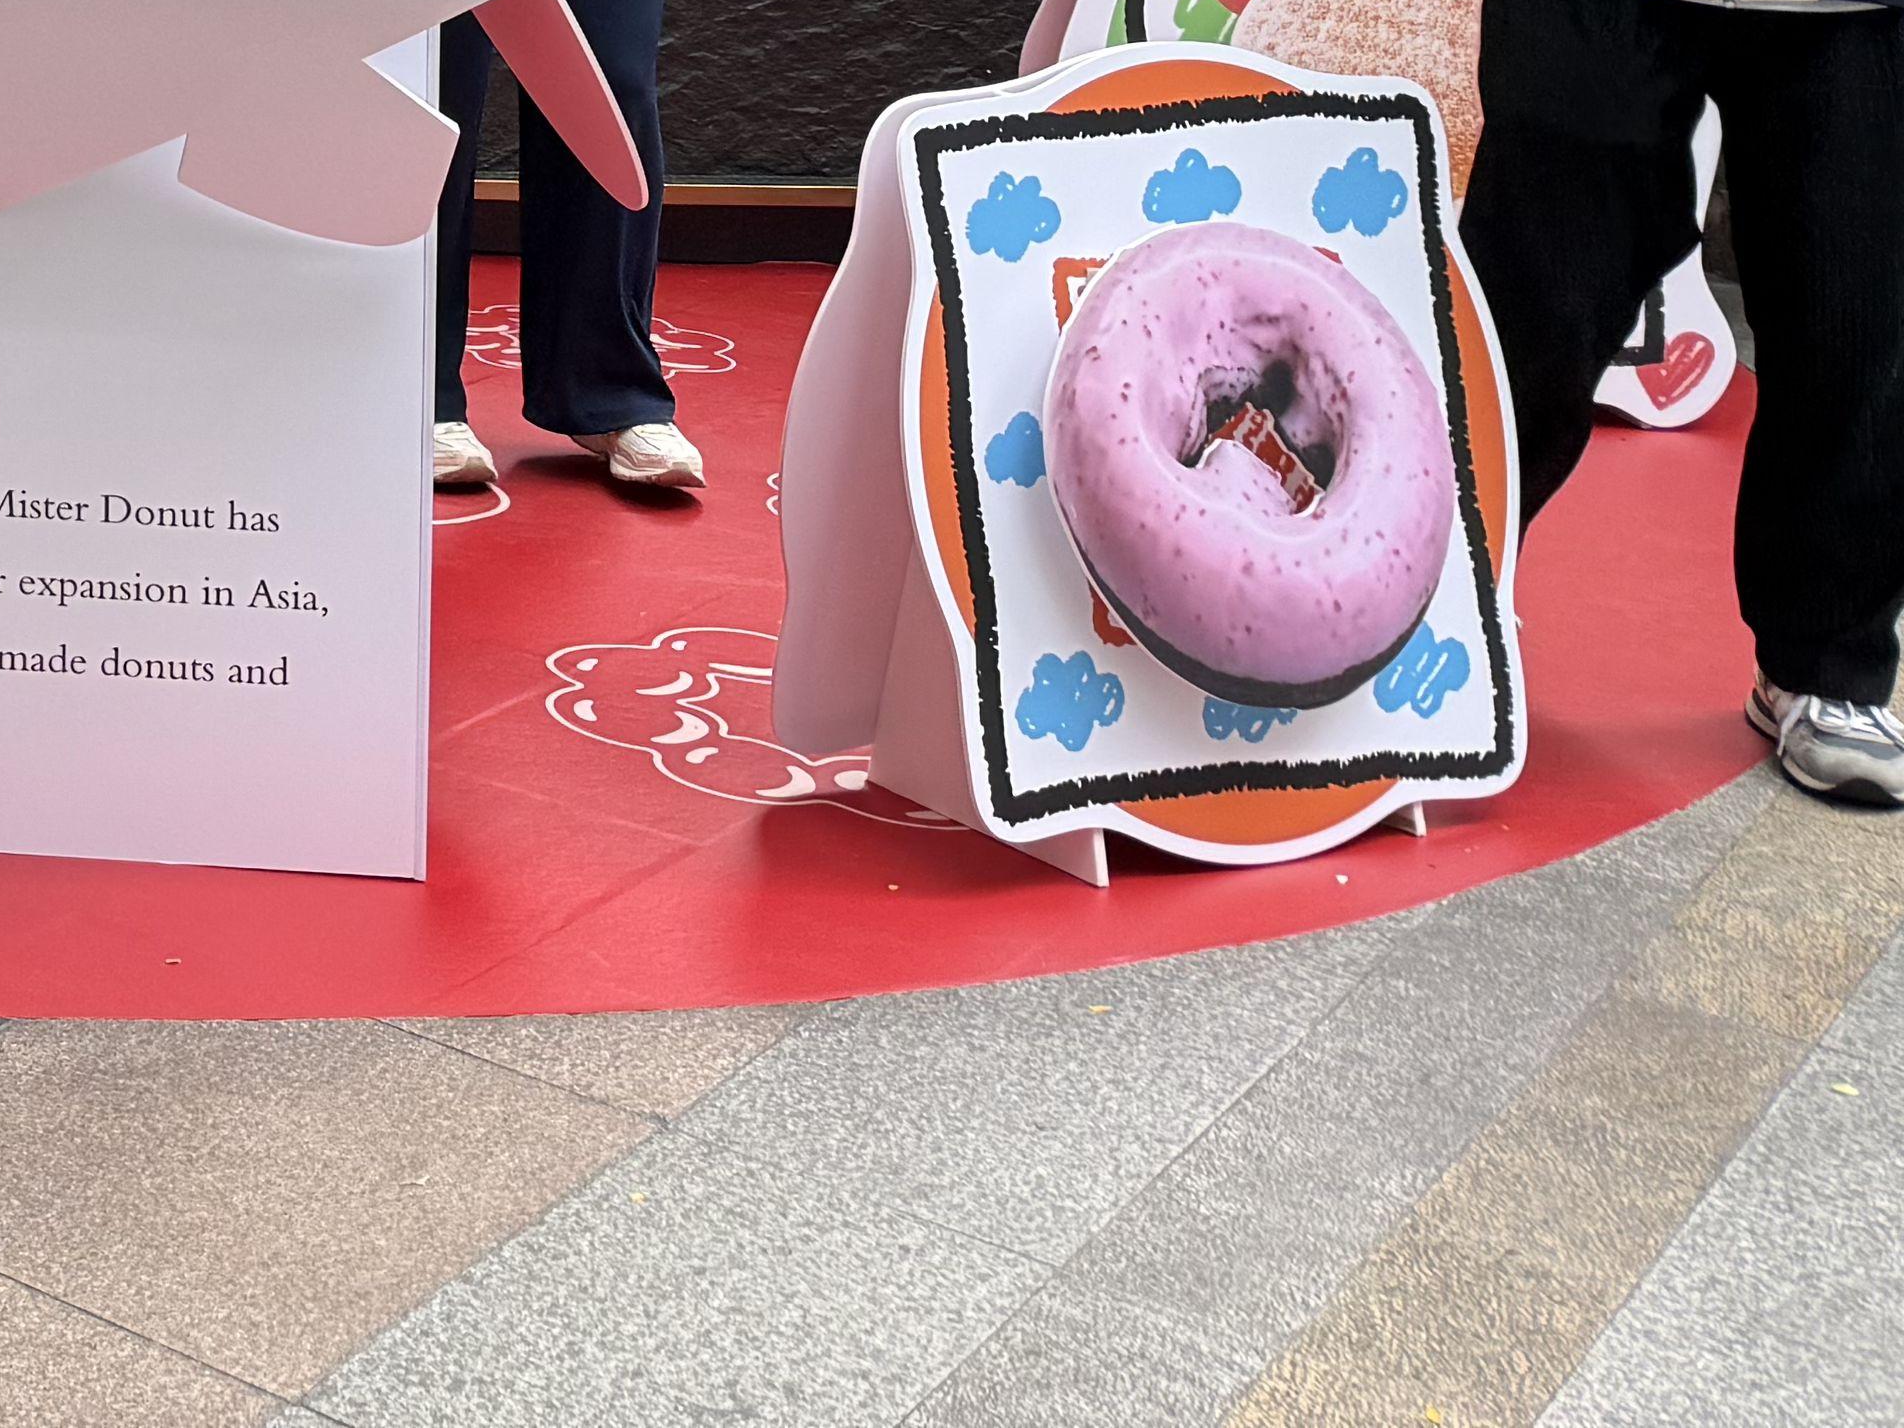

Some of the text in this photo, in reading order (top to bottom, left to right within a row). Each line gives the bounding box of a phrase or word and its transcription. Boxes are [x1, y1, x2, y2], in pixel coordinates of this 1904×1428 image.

[99, 494, 216, 529] Donut
[226, 499, 280, 533] has
[18, 572, 190, 608] expansion
[200, 575, 236, 607] in
[246, 578, 329, 618] Asia,
[100, 646, 215, 683] donuts
[227, 655, 290, 687] and
